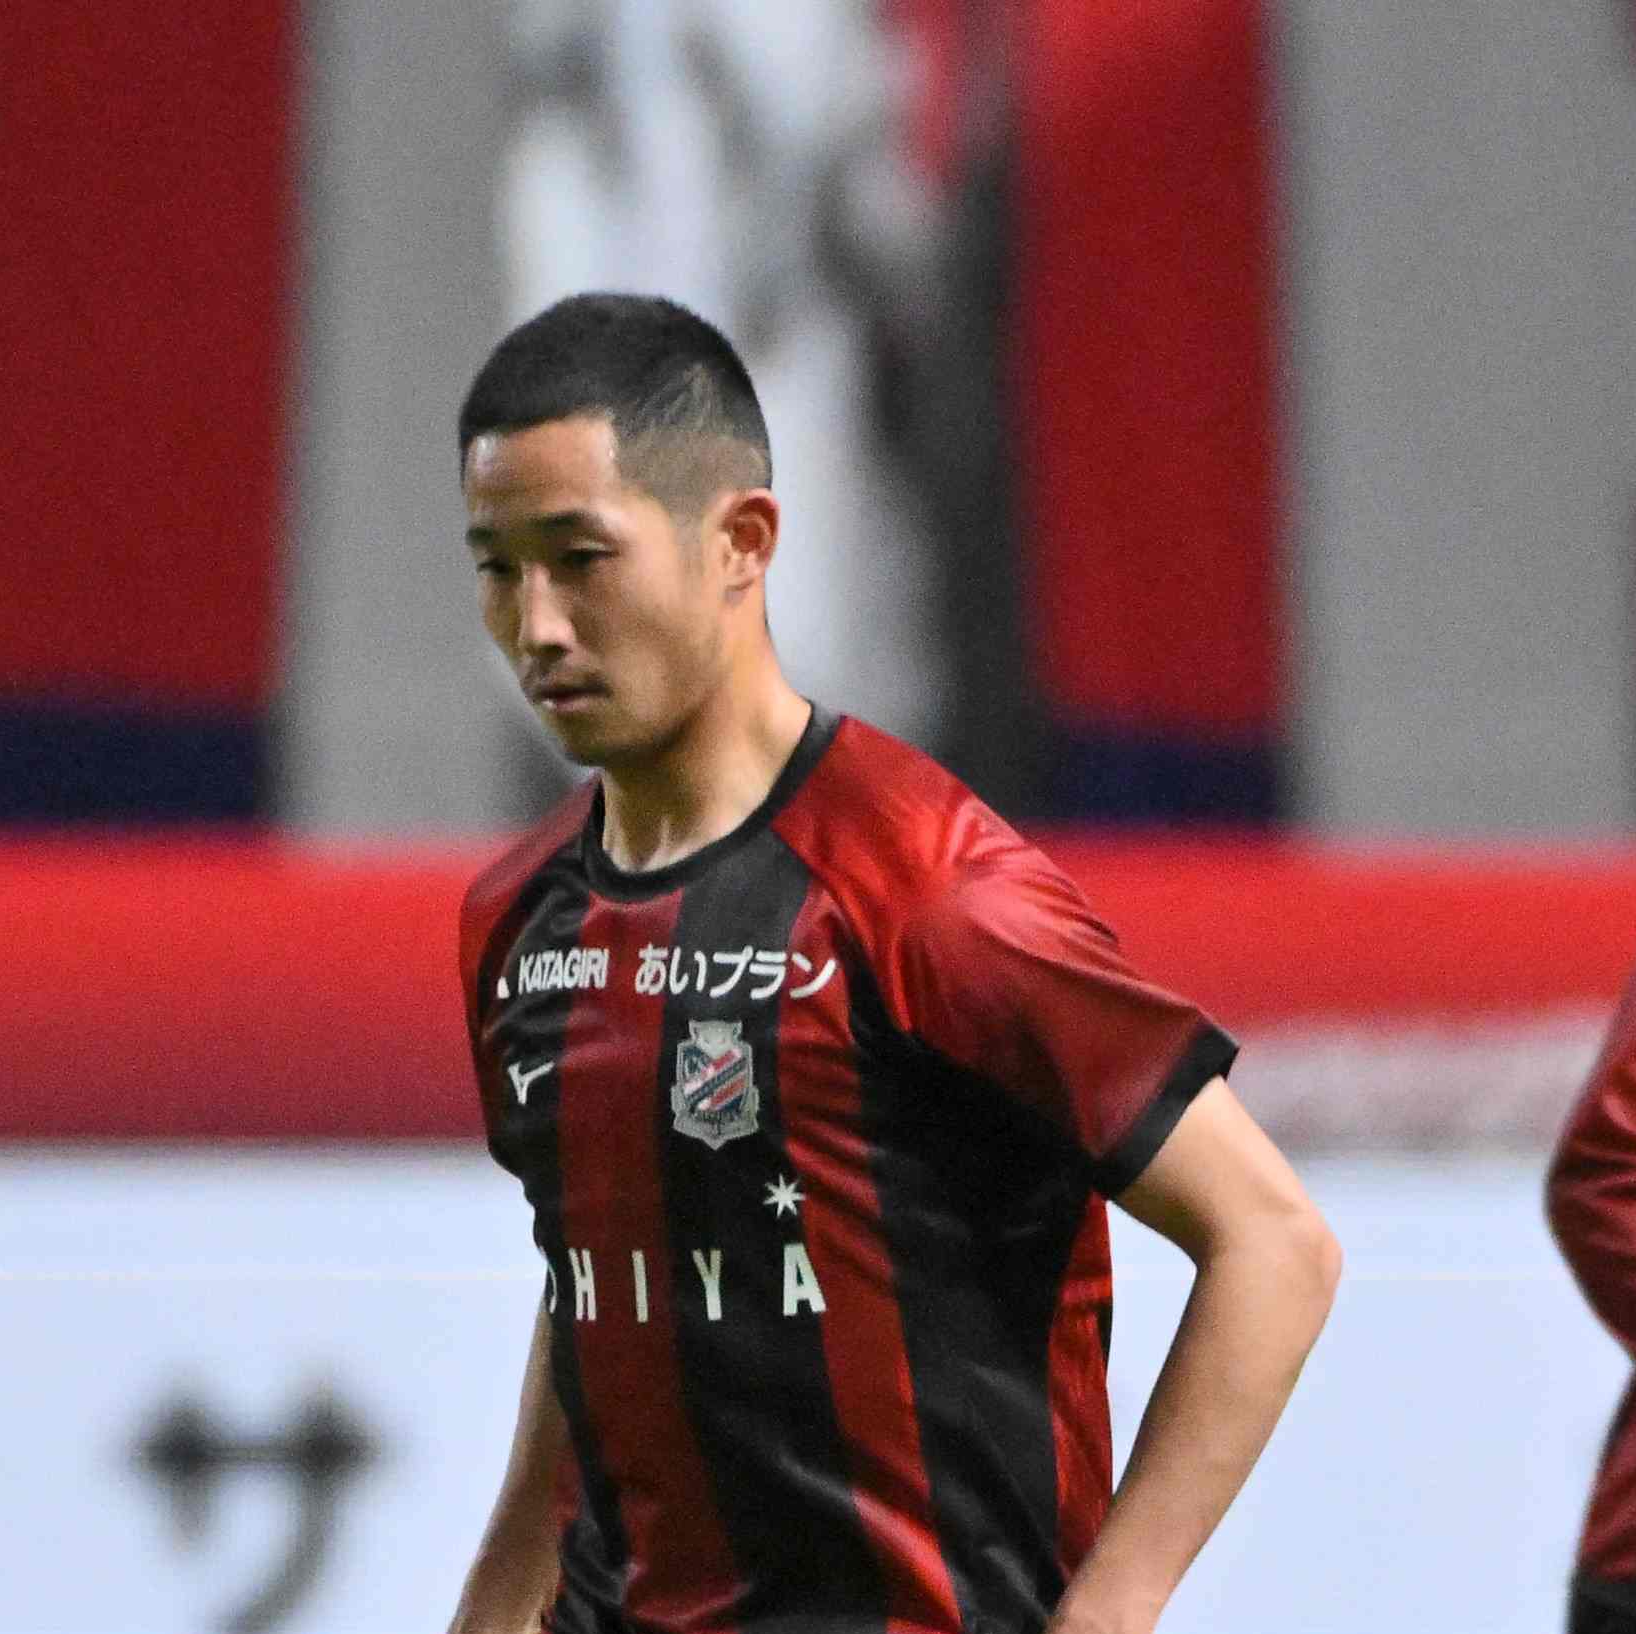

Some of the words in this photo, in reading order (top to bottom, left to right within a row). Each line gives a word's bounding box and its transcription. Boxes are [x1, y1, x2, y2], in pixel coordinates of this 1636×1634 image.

[517, 948, 609, 994] KATAGIRI
[634, 943, 838, 1001] あいプラン
[539, 1243, 827, 1324] HIYA
